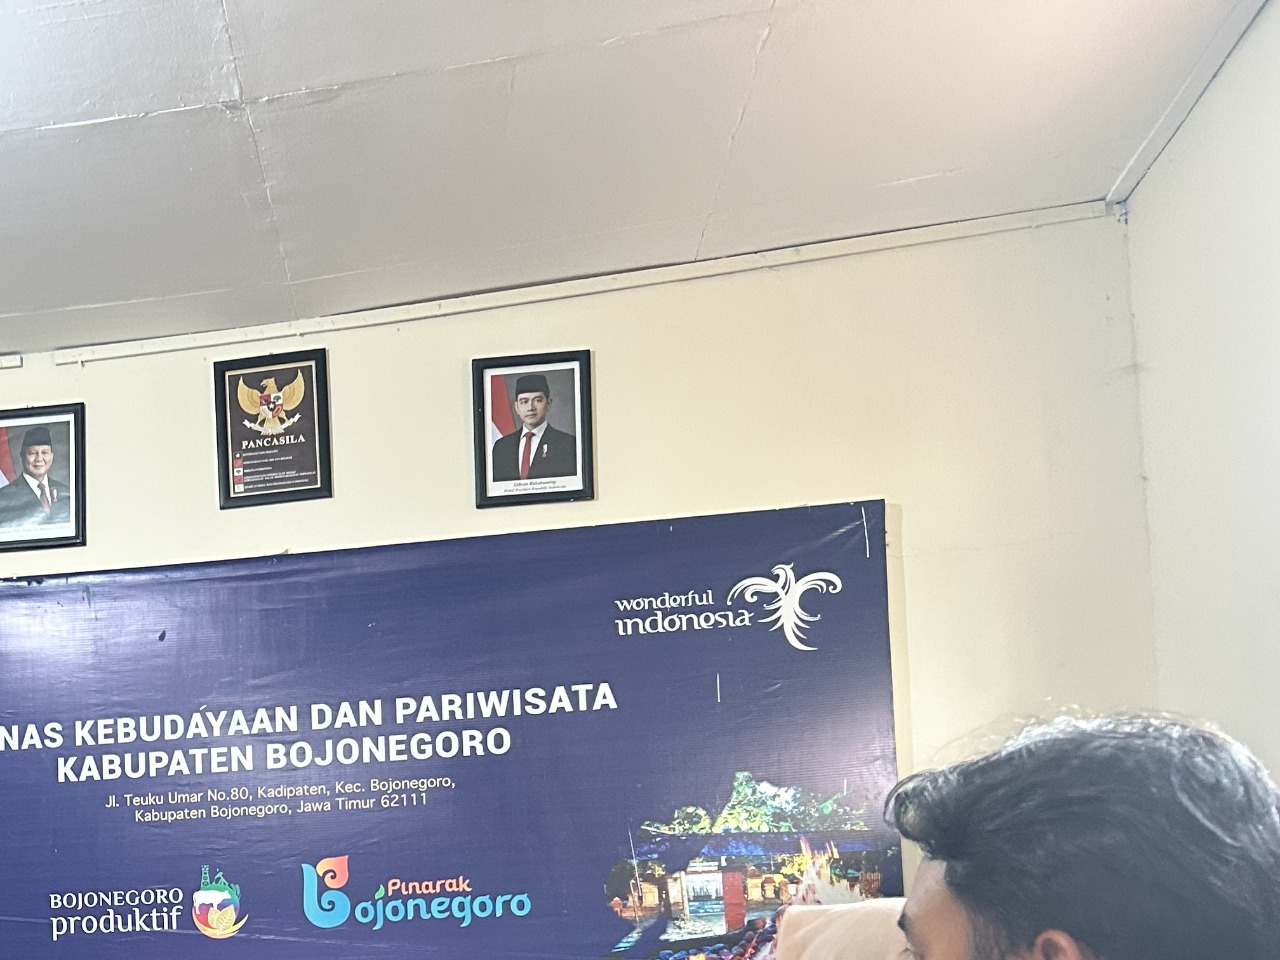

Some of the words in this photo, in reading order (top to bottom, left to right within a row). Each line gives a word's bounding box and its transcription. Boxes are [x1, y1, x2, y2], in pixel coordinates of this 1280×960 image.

[241, 434, 306, 449] PANCASILA
[614, 590, 715, 612] wonderful
[614, 609, 754, 635] indonesia
[75, 705, 298, 747] KEBUDAYAAN
[311, 699, 382, 730] DAN
[395, 682, 618, 724] PARIWISATA
[57, 745, 253, 783] KABUPATEN
[266, 727, 511, 770] BOJONEGORO
[105, 795, 120, 808] Jl.
[124, 793, 163, 807] Teuku
[168, 791, 204, 804] Umar
[208, 786, 253, 803] No.80,
[257, 782, 331, 801] Kadipaten,
[335, 780, 365, 794] Kec.
[370, 776, 456, 794] Bojonegoro,
[135, 807, 206, 823] Kabupaten
[210, 802, 292, 820] Bojonegoro,
[296, 800, 331, 813] Jawa
[335, 796, 375, 811] Timur
[380, 792, 428, 808] 62111
[49, 887, 184, 910] BOJONEGORO
[388, 875, 472, 897] Pinarak
[50, 905, 184, 941] produktif
